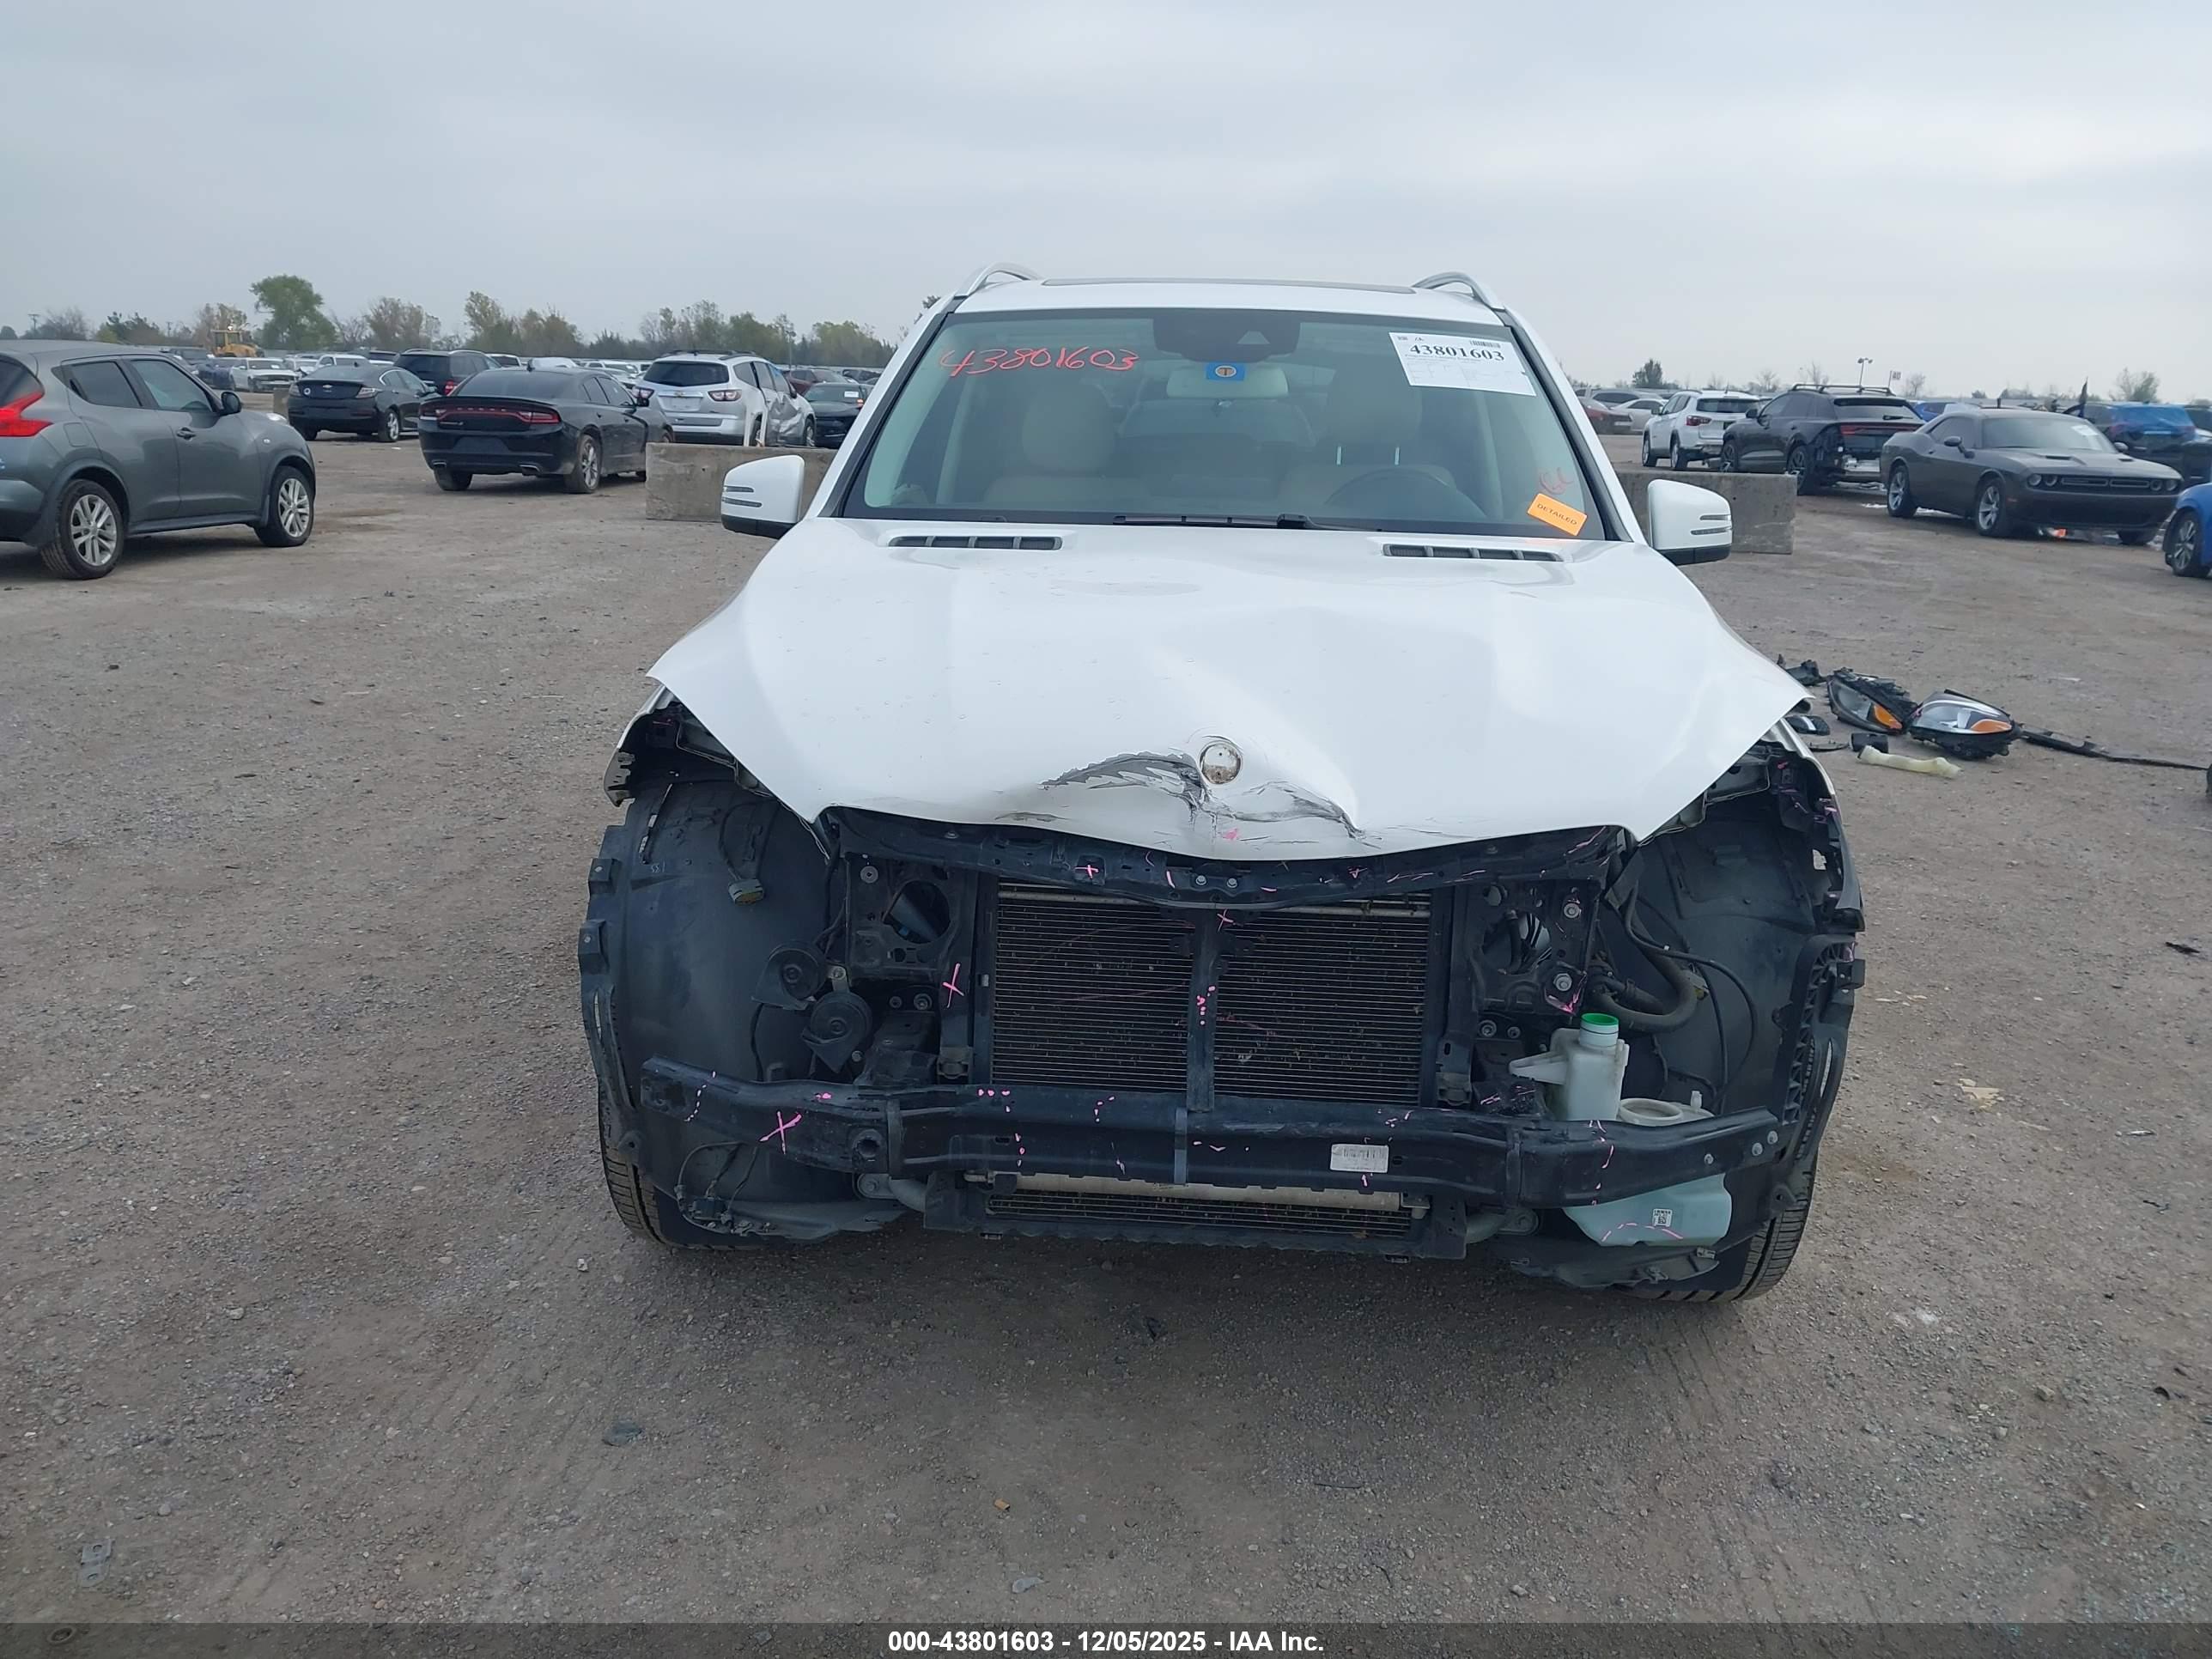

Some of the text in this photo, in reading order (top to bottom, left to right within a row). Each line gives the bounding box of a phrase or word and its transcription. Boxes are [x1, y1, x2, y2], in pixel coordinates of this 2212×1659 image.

[939, 346, 1140, 377] 43801603
[1410, 343, 1505, 362] 43801603
[1536, 502, 1578, 526] DETAILED
